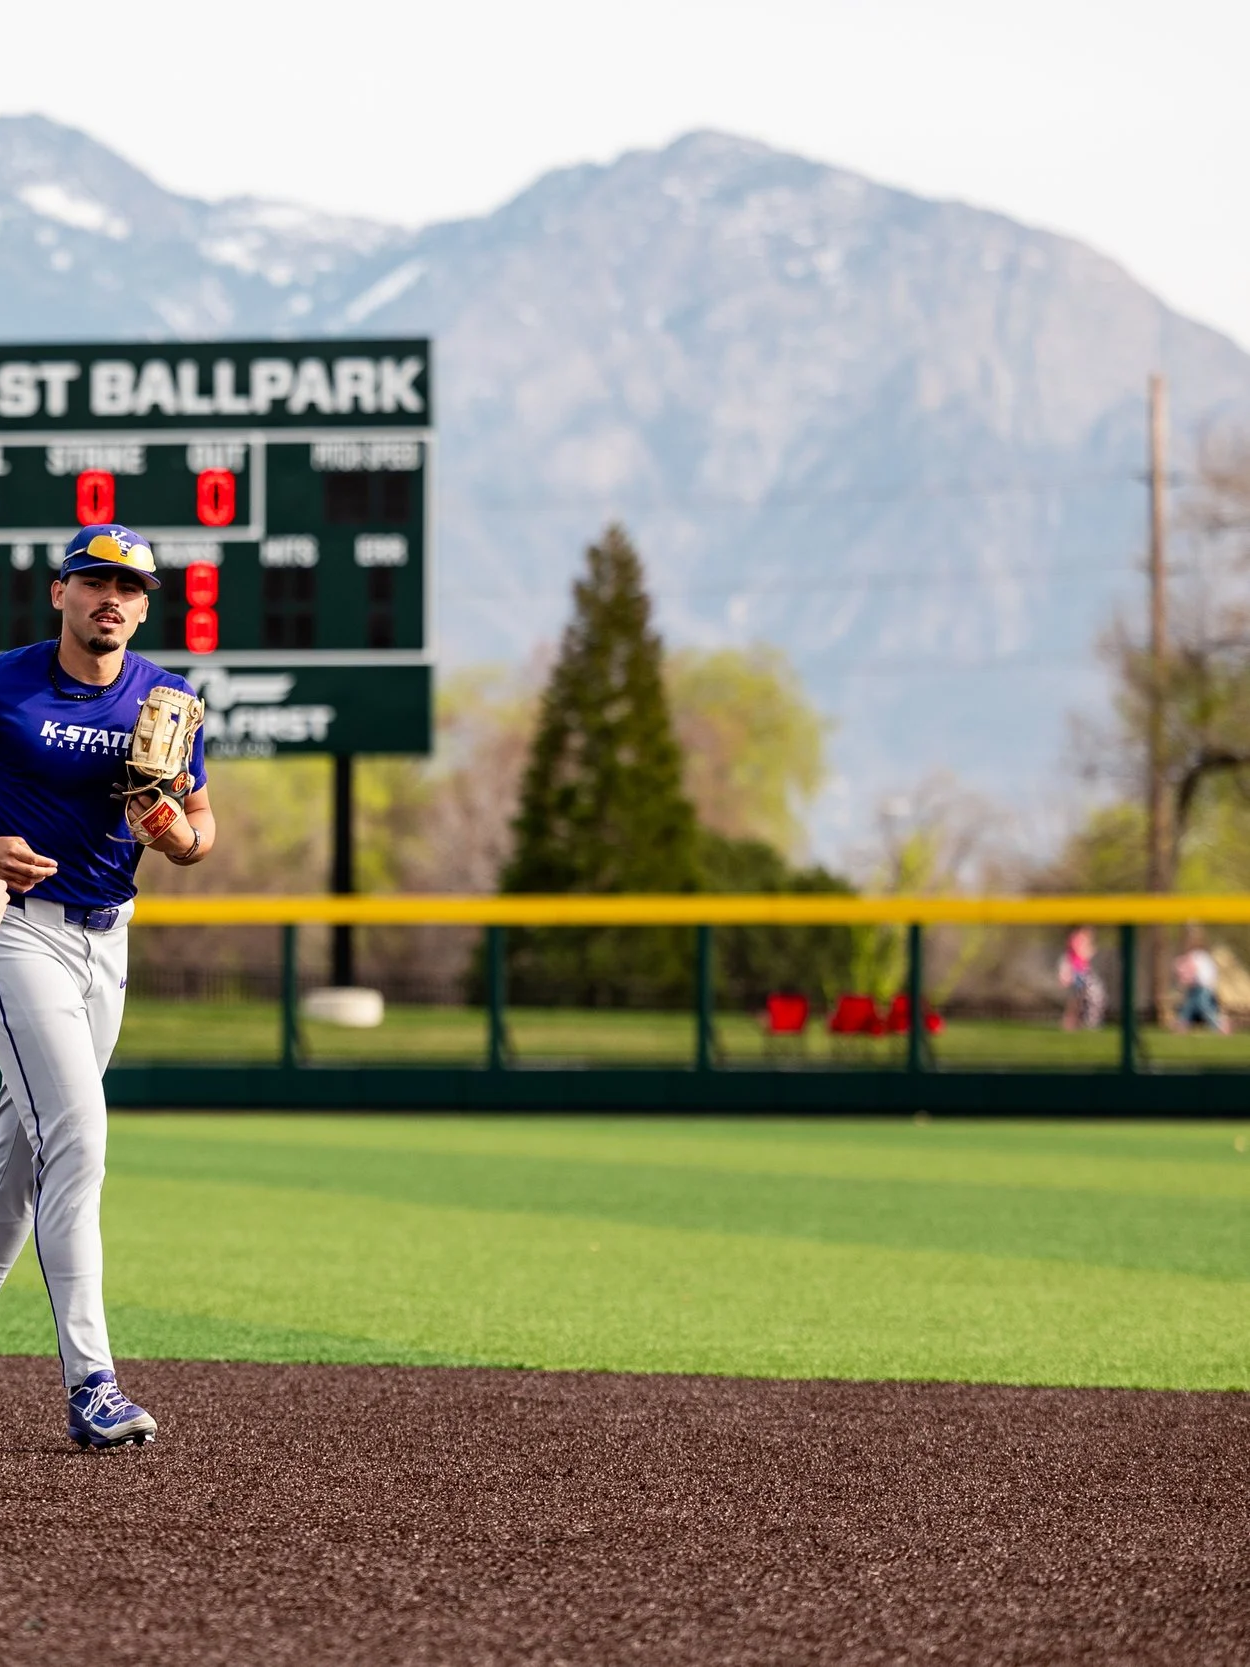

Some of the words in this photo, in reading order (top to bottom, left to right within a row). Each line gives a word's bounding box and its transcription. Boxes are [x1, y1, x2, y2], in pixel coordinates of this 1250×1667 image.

[88, 355, 425, 417] BALLPARK
[45, 439, 147, 476] STRIKE
[186, 438, 248, 474] OUT
[76, 468, 116, 527] 0
[196, 467, 236, 527] 0
[227, 703, 337, 743] FIRST
